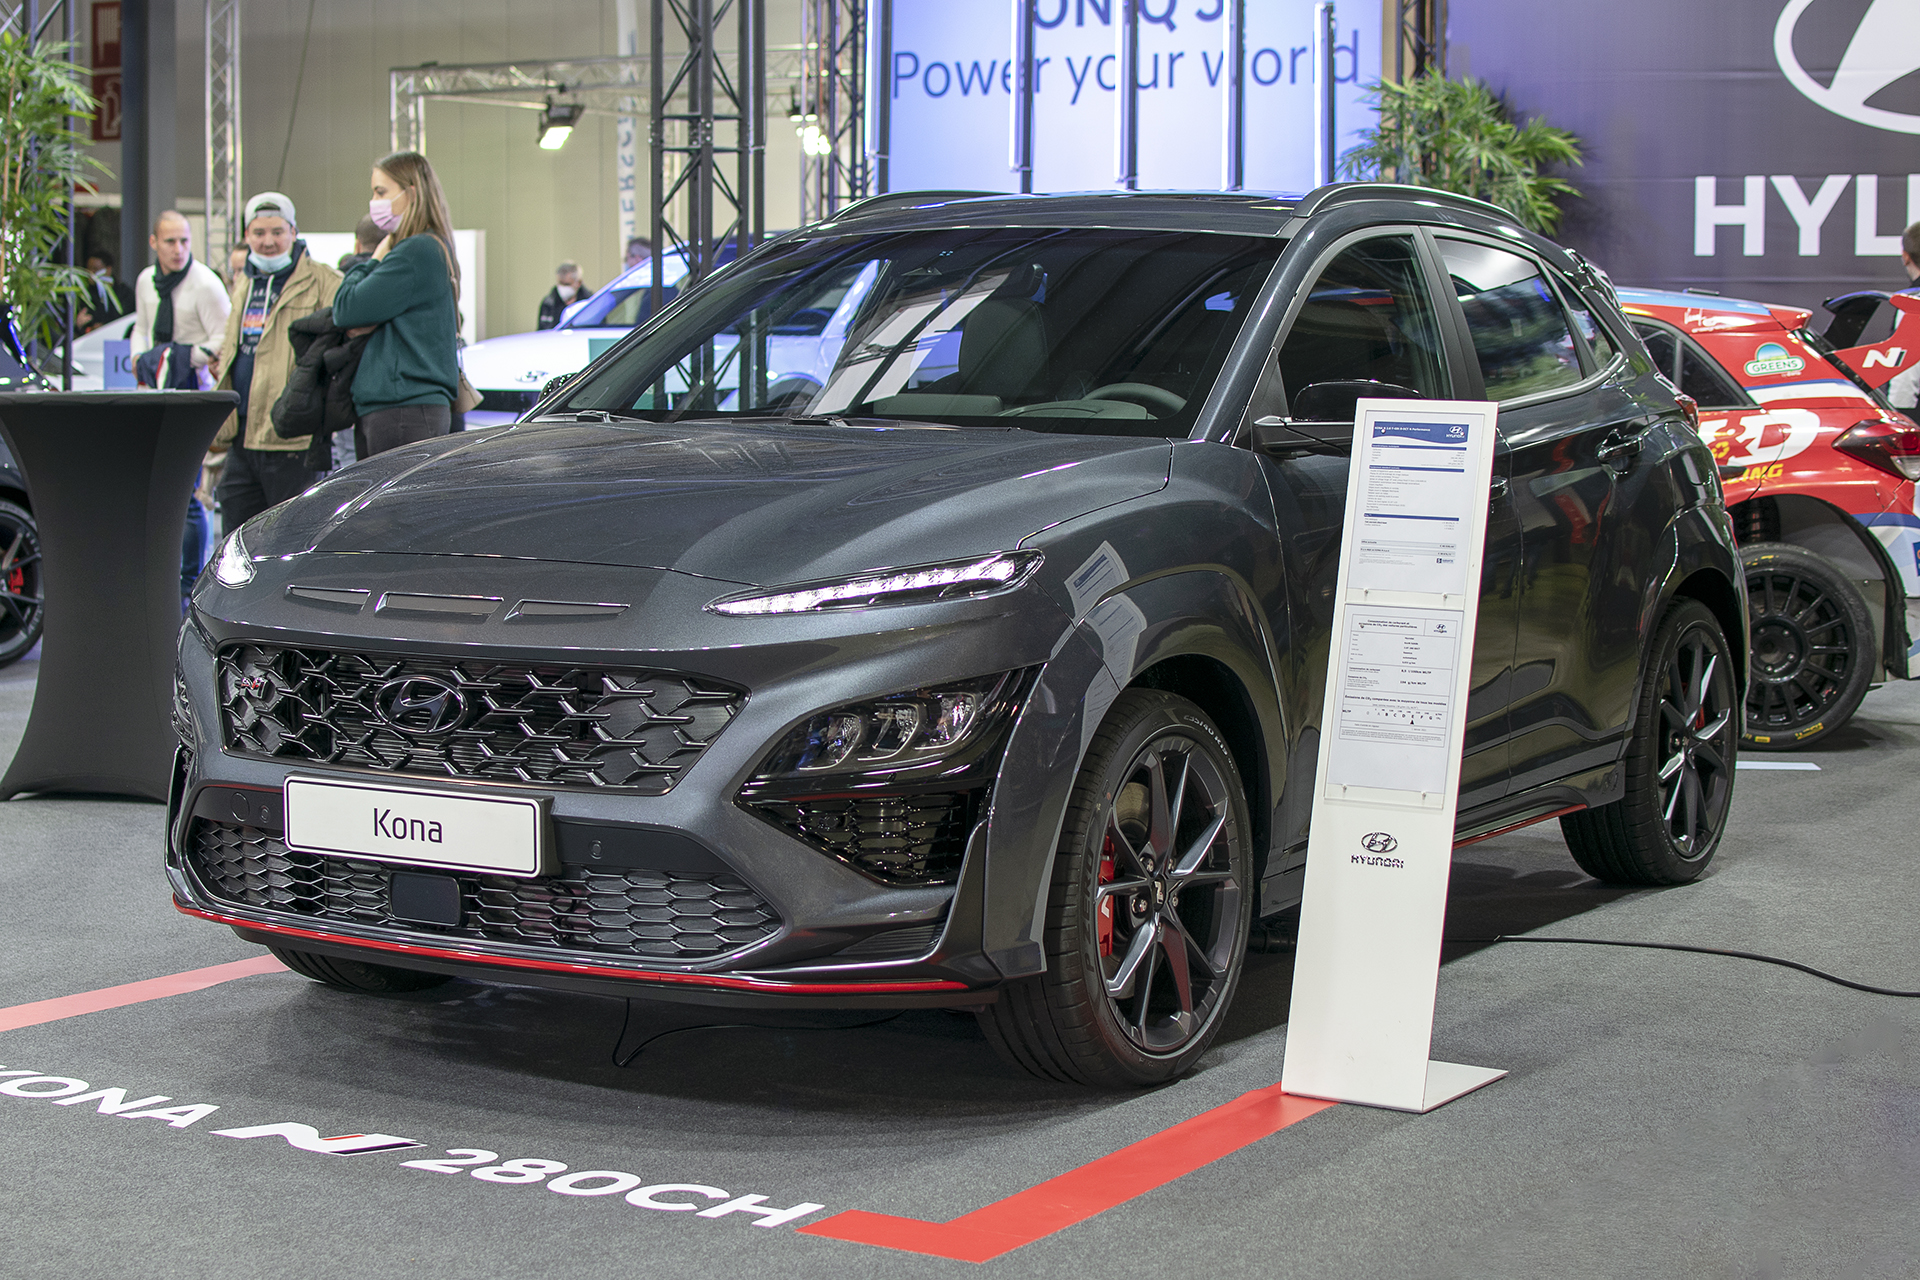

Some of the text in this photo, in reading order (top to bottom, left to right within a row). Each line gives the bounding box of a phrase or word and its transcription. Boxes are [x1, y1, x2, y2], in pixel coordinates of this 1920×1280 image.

[1752, 360, 1800, 373] GREENS
[373, 807, 443, 843] Kona
[1351, 854, 1404, 869] HYUNDAI
[400, 1148, 825, 1228] 280CH
